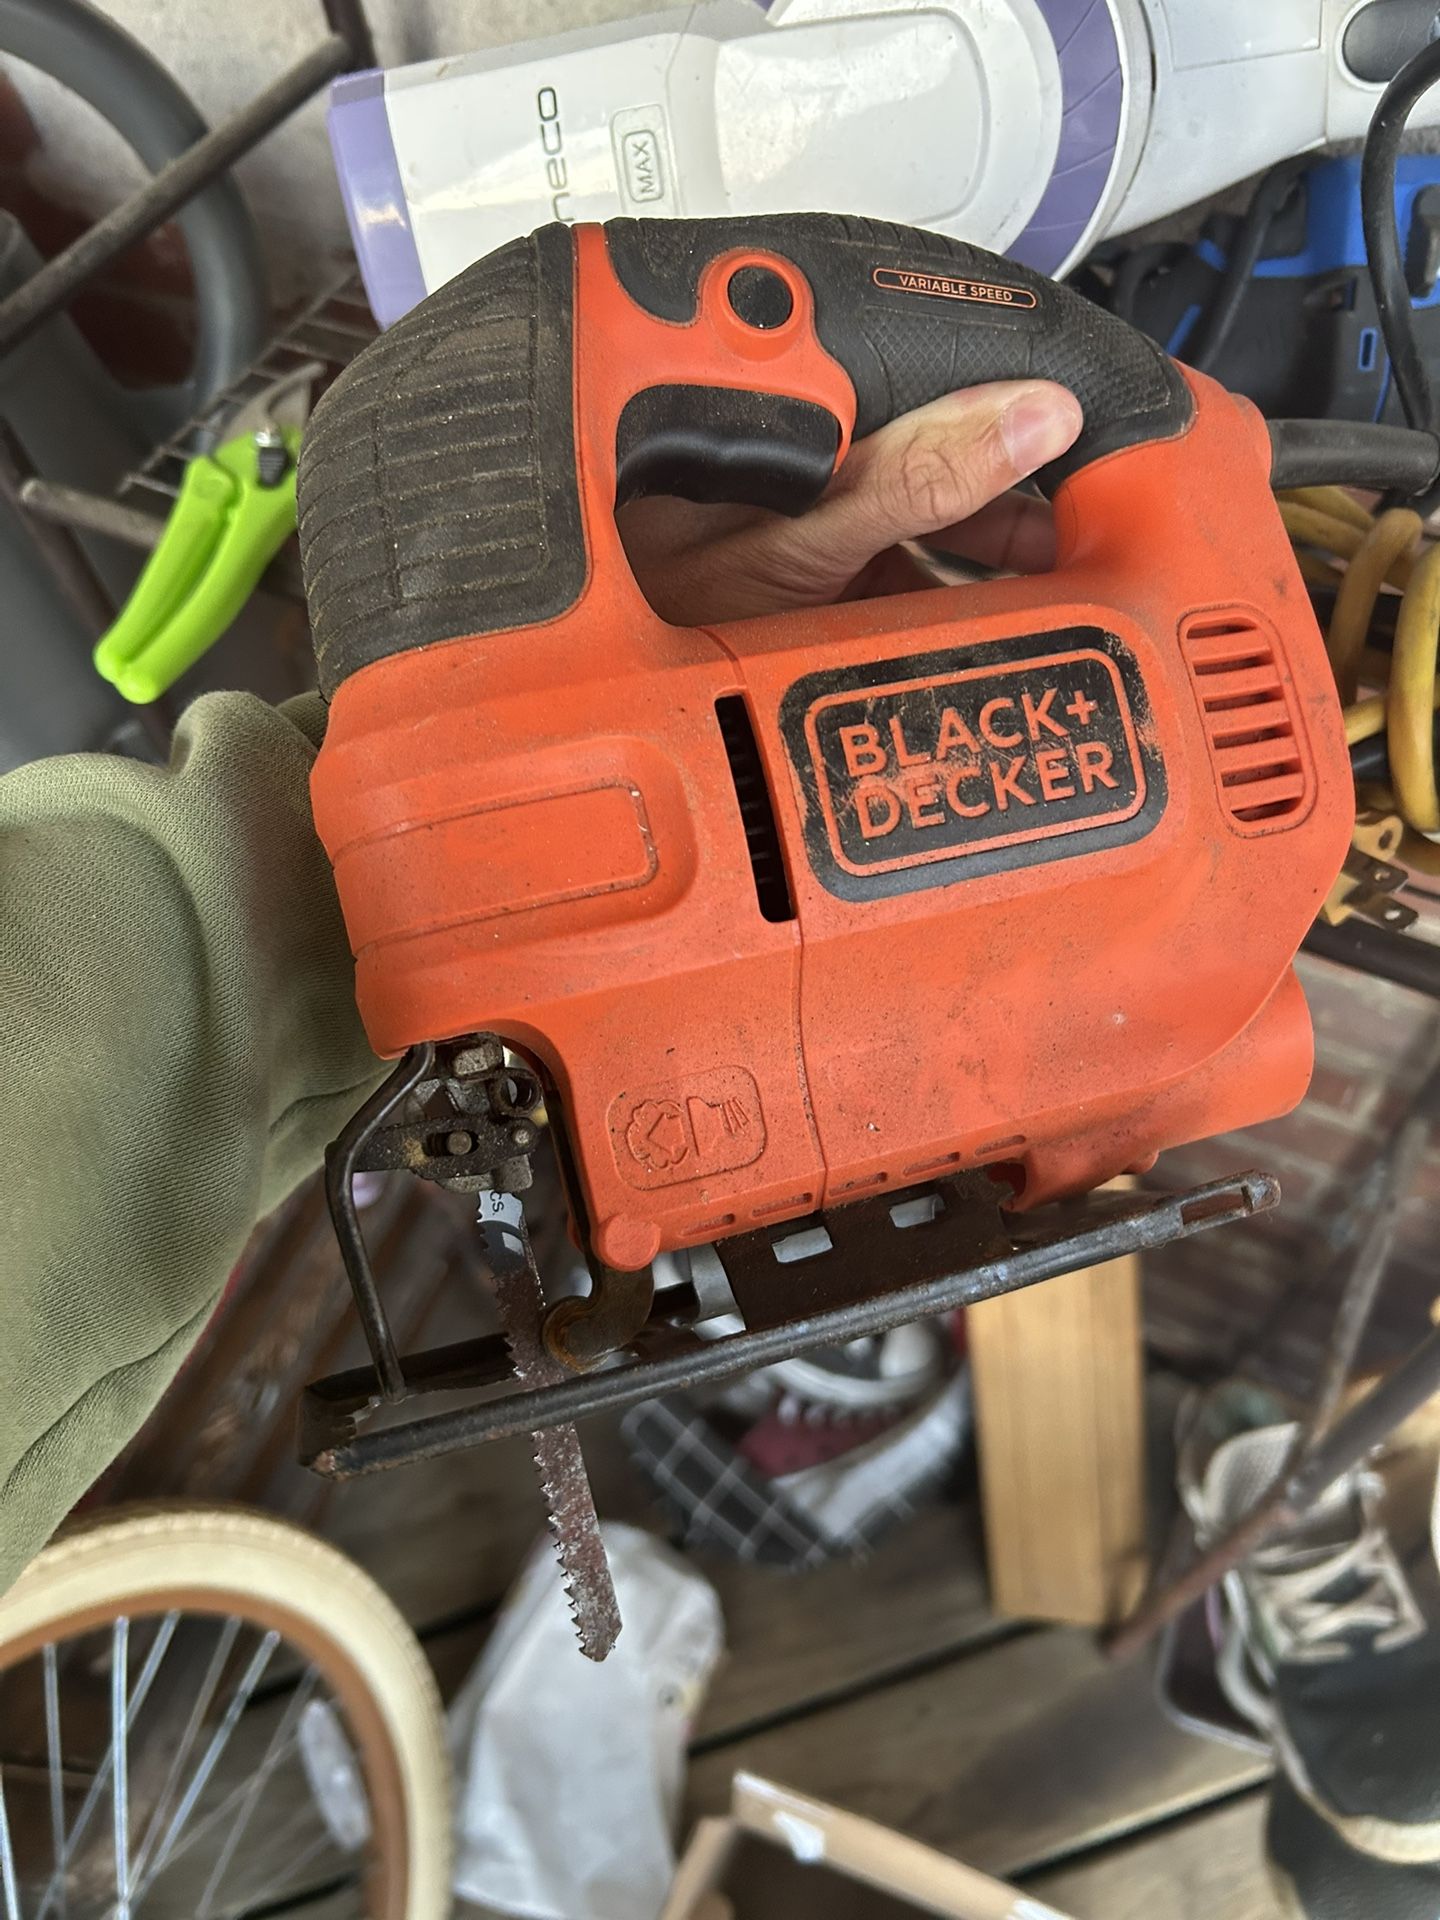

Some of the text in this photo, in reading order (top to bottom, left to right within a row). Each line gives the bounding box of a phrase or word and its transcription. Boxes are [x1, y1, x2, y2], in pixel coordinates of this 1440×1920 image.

[632, 141, 655, 193] MAX
[899, 275, 1013, 302] VARIABLE SPEED
[839, 687, 1098, 777] BLACK+
[853, 741, 1119, 839] DECKER
